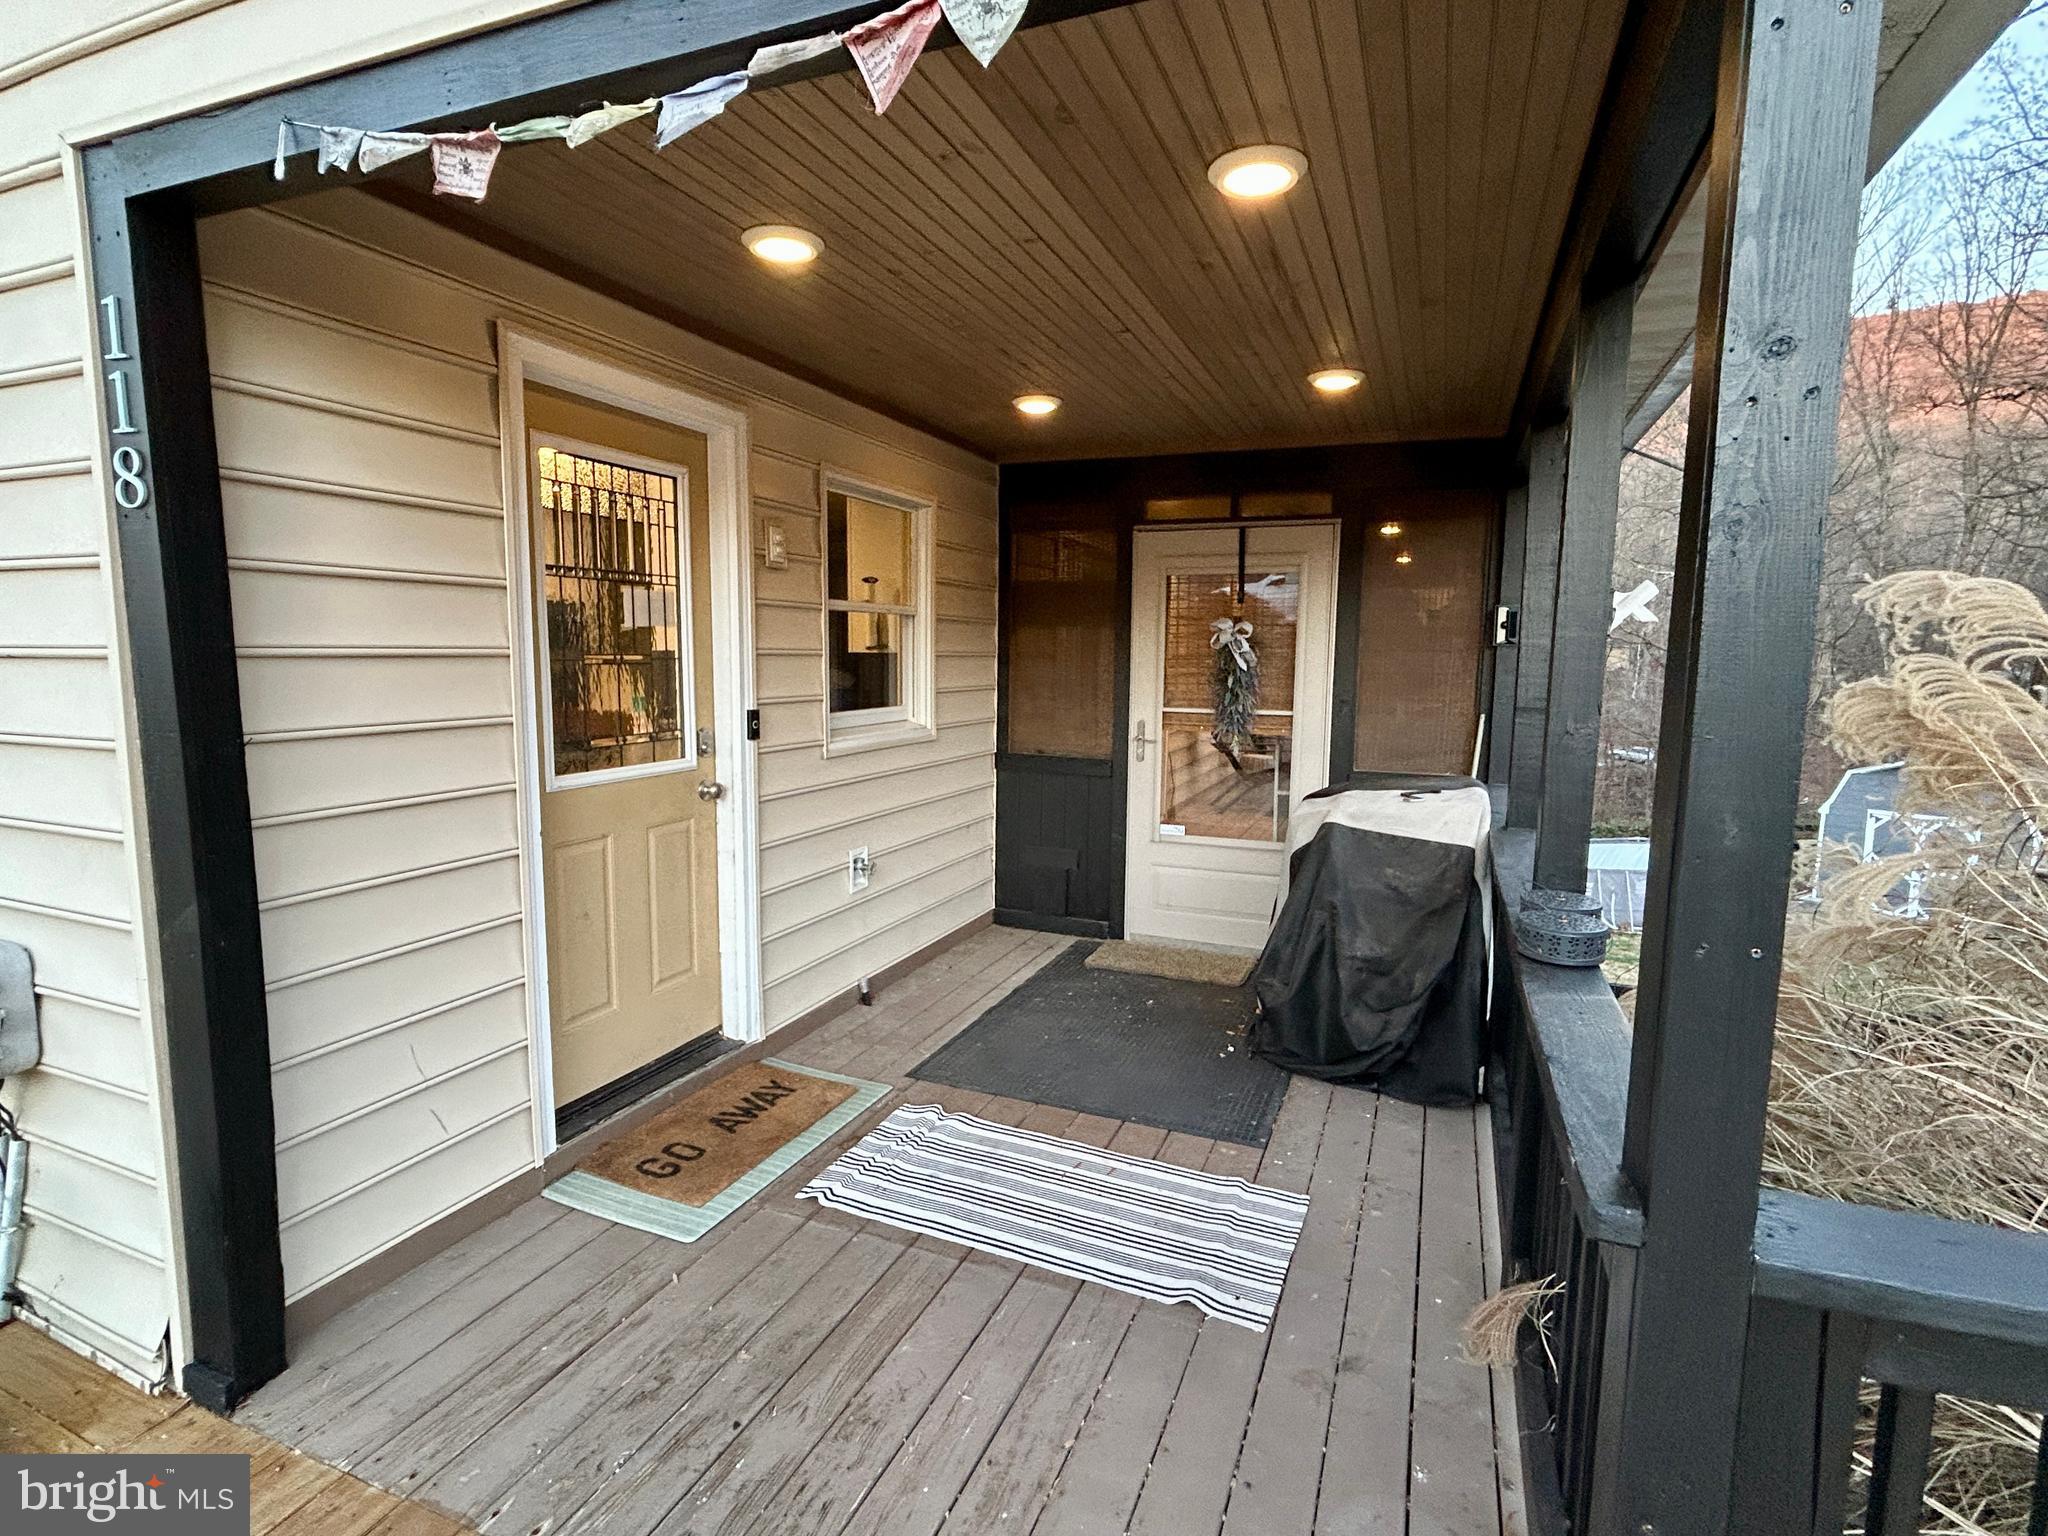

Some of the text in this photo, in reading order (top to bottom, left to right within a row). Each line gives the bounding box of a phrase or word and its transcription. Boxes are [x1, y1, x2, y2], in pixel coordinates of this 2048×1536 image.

[101, 294, 148, 509] 118
[635, 1080, 797, 1179] GO AWAY
